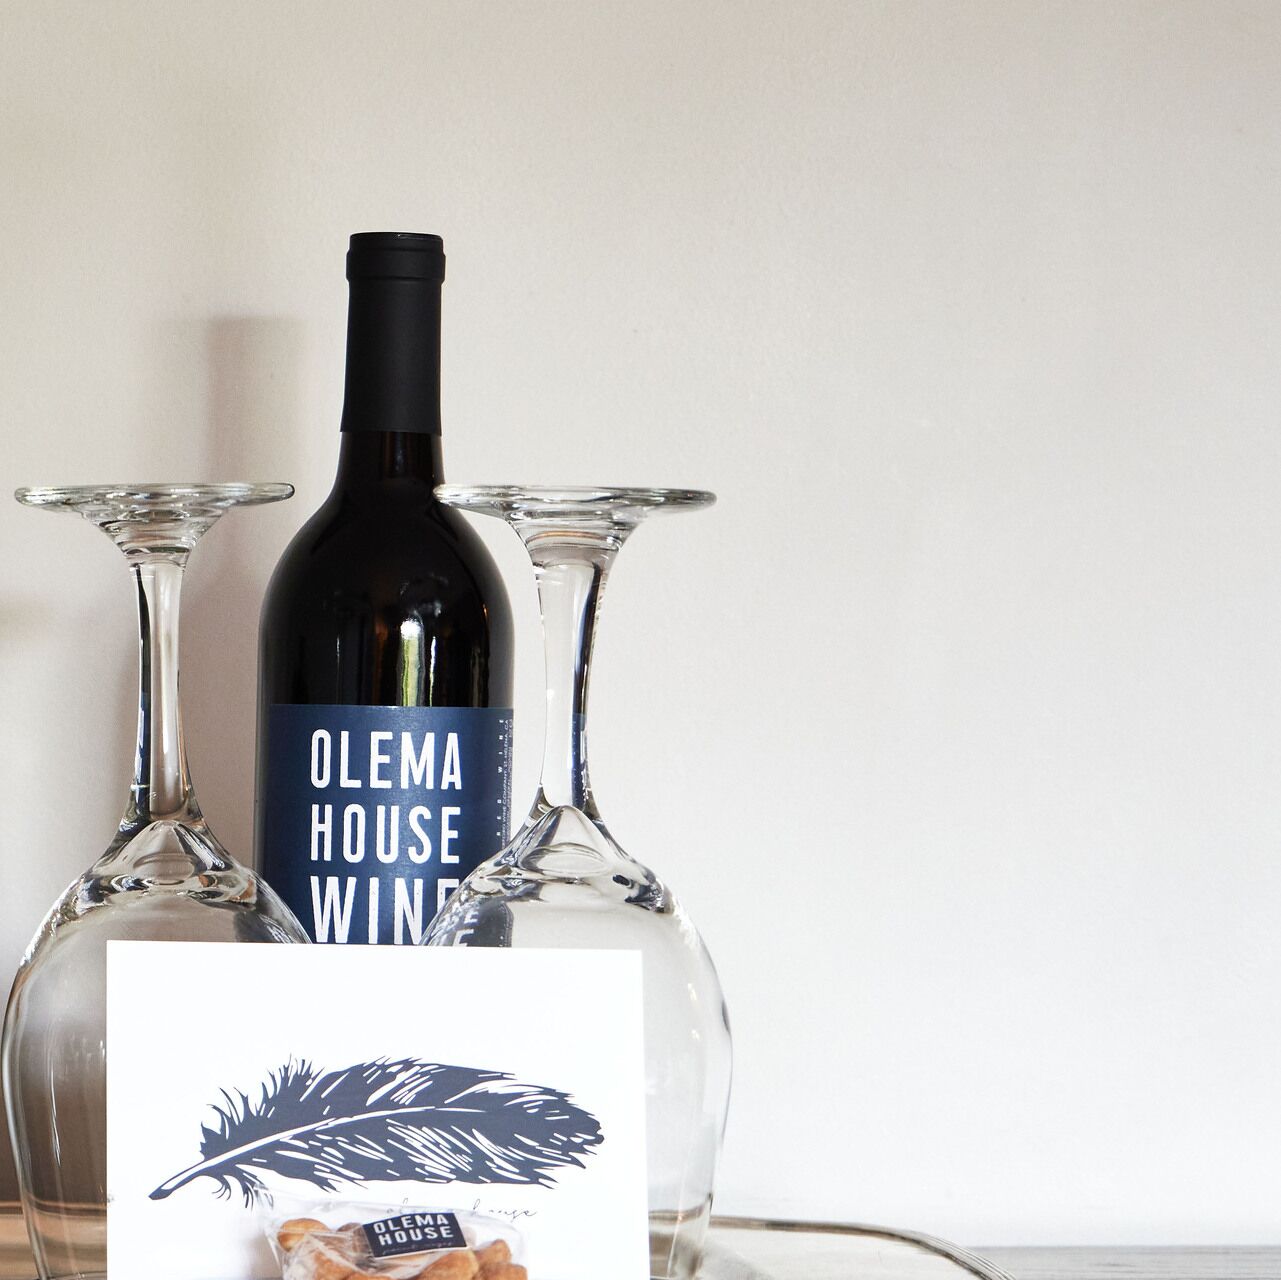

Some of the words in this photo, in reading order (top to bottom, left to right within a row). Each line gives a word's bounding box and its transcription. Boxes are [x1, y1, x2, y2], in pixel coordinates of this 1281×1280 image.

[310, 728, 463, 791] OLEMA
[310, 803, 461, 864] HOUSE
[372, 1213, 450, 1234] OLEMA
[378, 1225, 454, 1246] HOUSE
